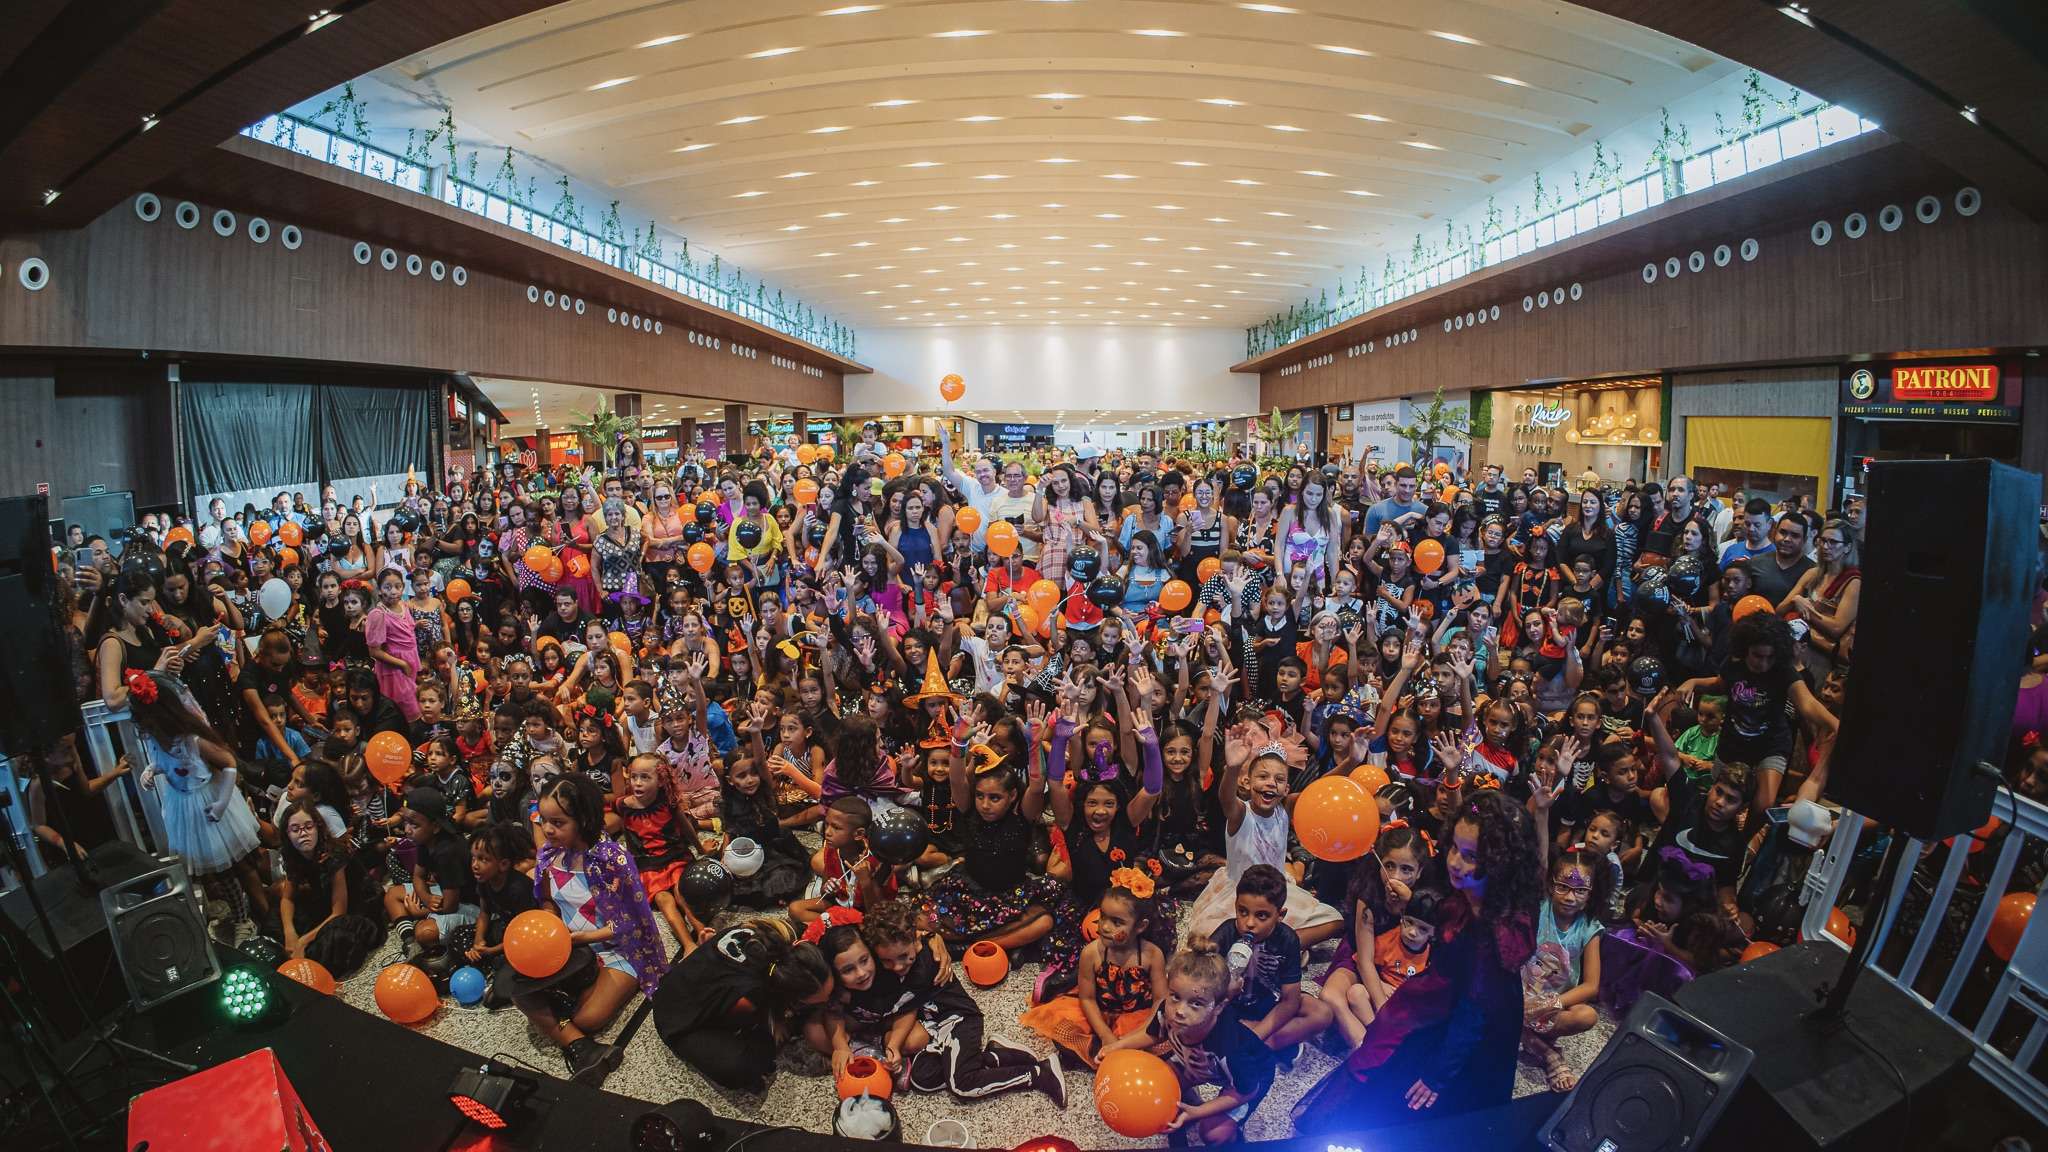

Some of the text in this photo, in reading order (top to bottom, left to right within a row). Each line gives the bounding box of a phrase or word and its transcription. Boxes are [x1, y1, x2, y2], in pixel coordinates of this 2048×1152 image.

[1896, 368, 1991, 389] PATRONI
[1943, 408, 1969, 416] MASSAS
[1514, 424, 1556, 435] SENTIR
[1517, 444, 1553, 455] VIVER
